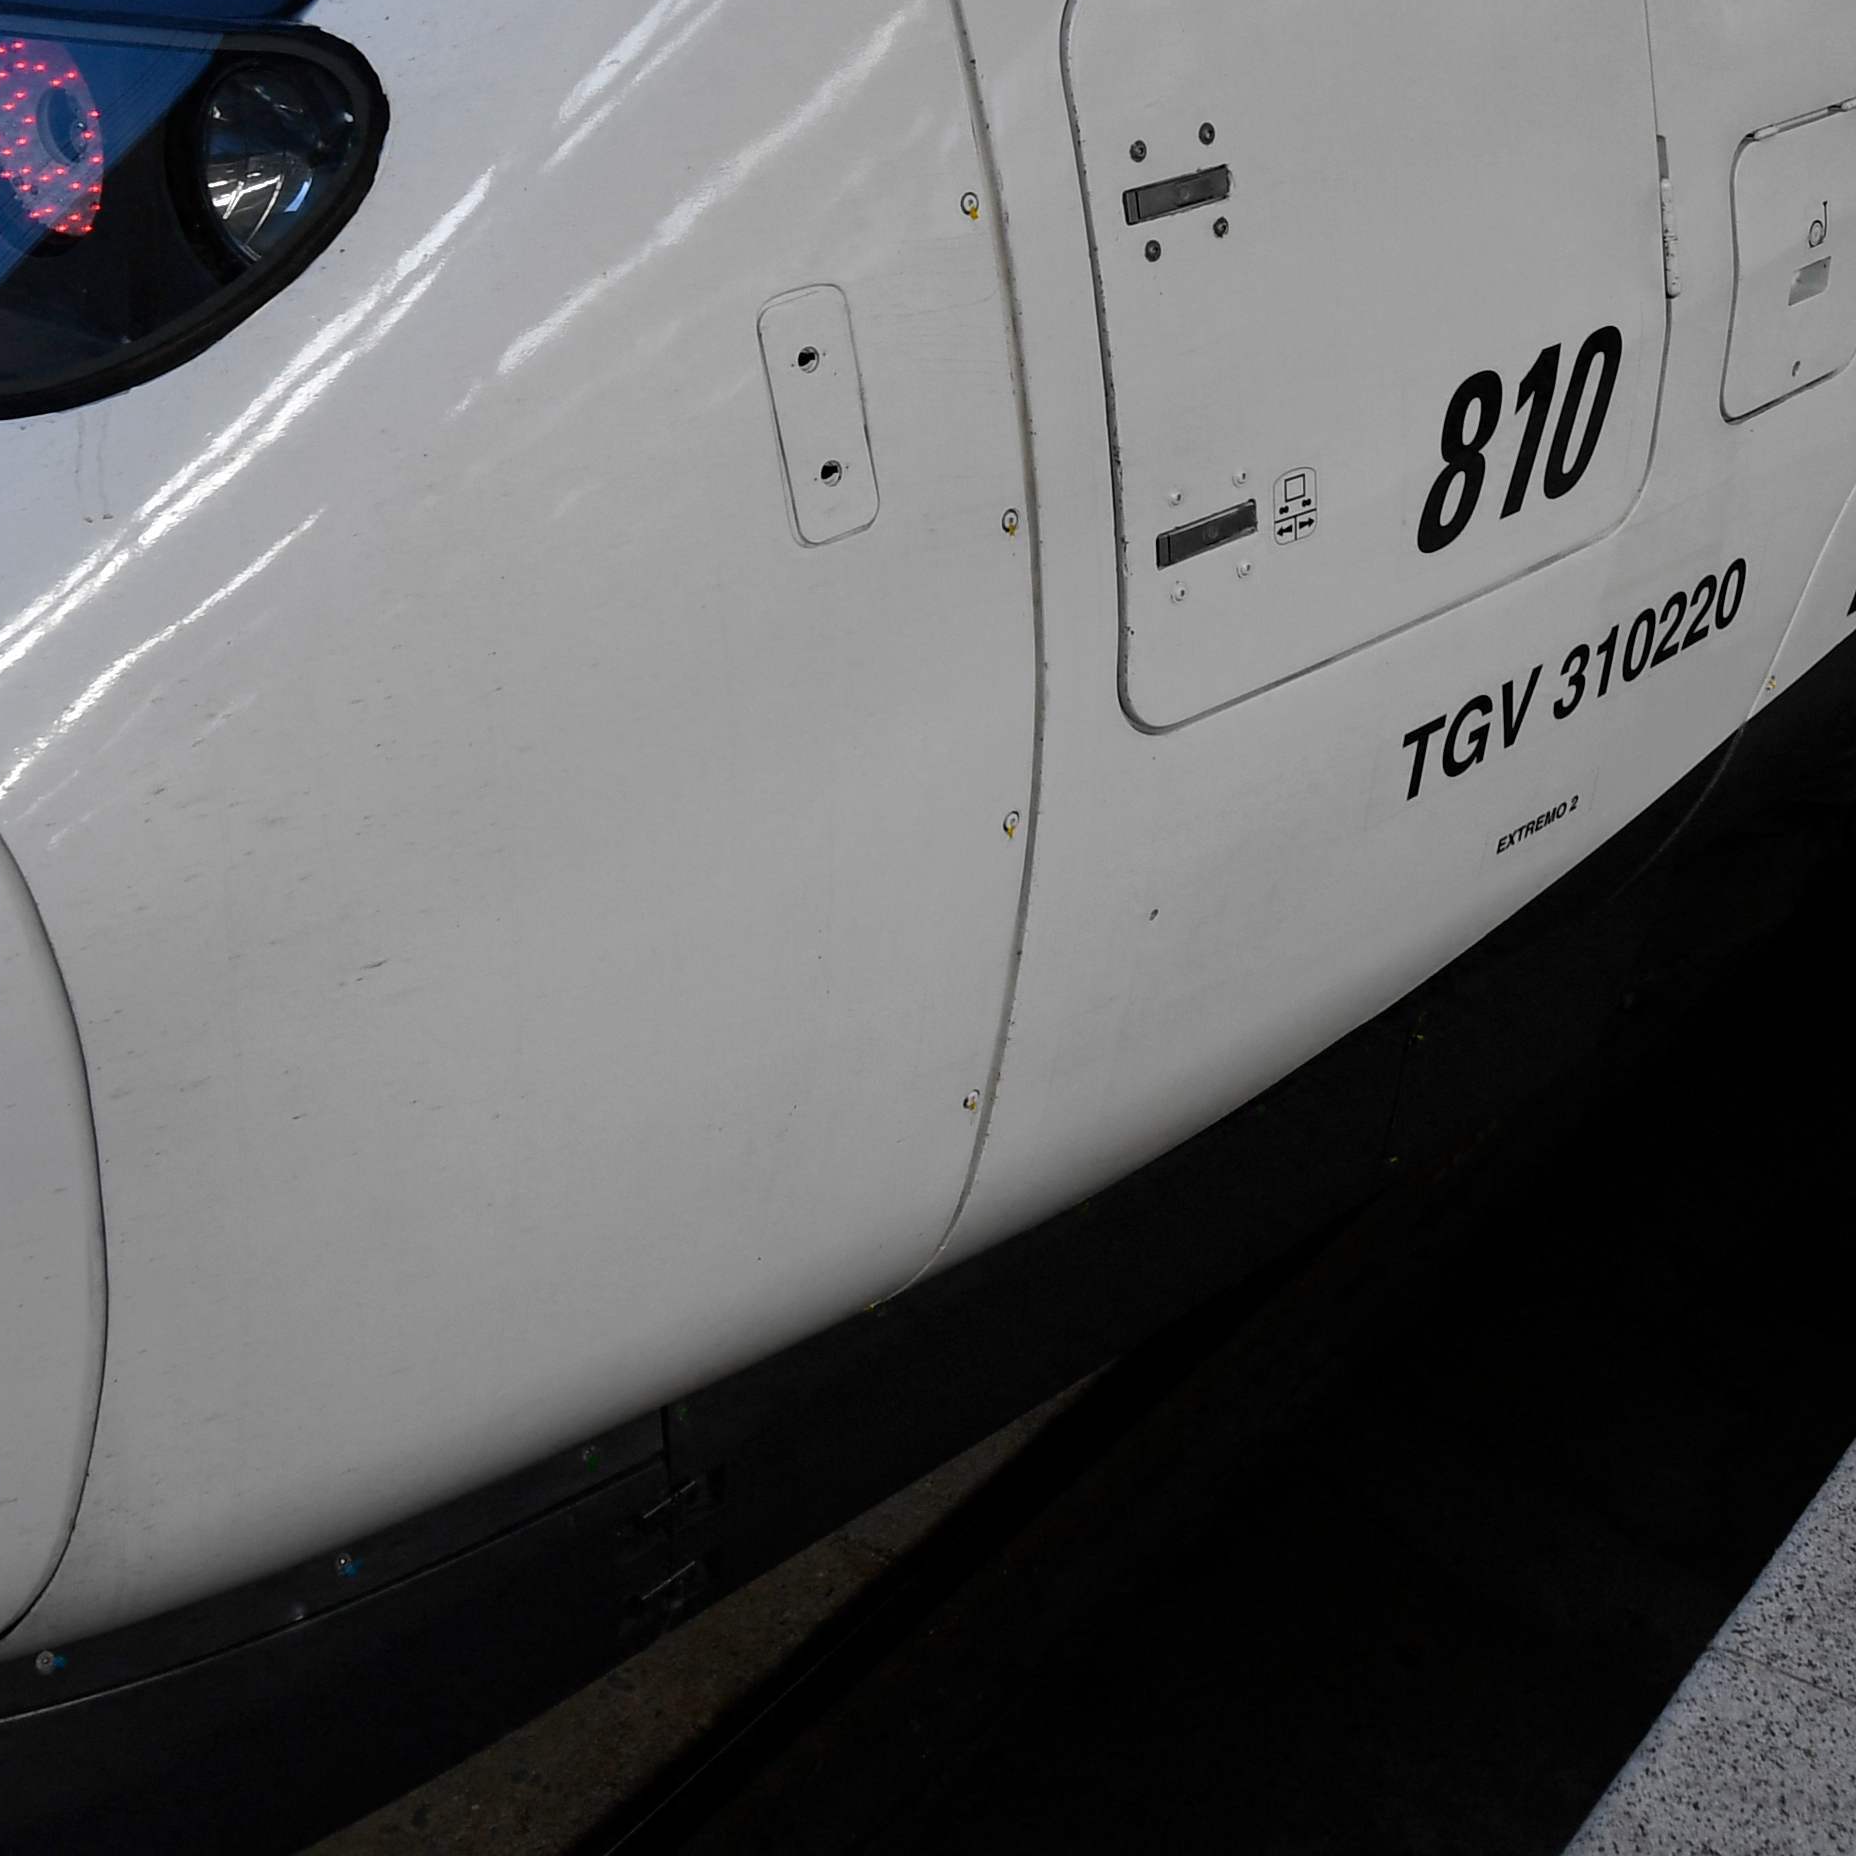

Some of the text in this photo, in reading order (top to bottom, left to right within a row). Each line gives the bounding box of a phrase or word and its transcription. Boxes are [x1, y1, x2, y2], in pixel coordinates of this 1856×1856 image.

[1416, 325, 1623, 554] 810
[1402, 557, 1747, 801] TGV 310220
[1496, 795, 1579, 855] EXTREMO 2
